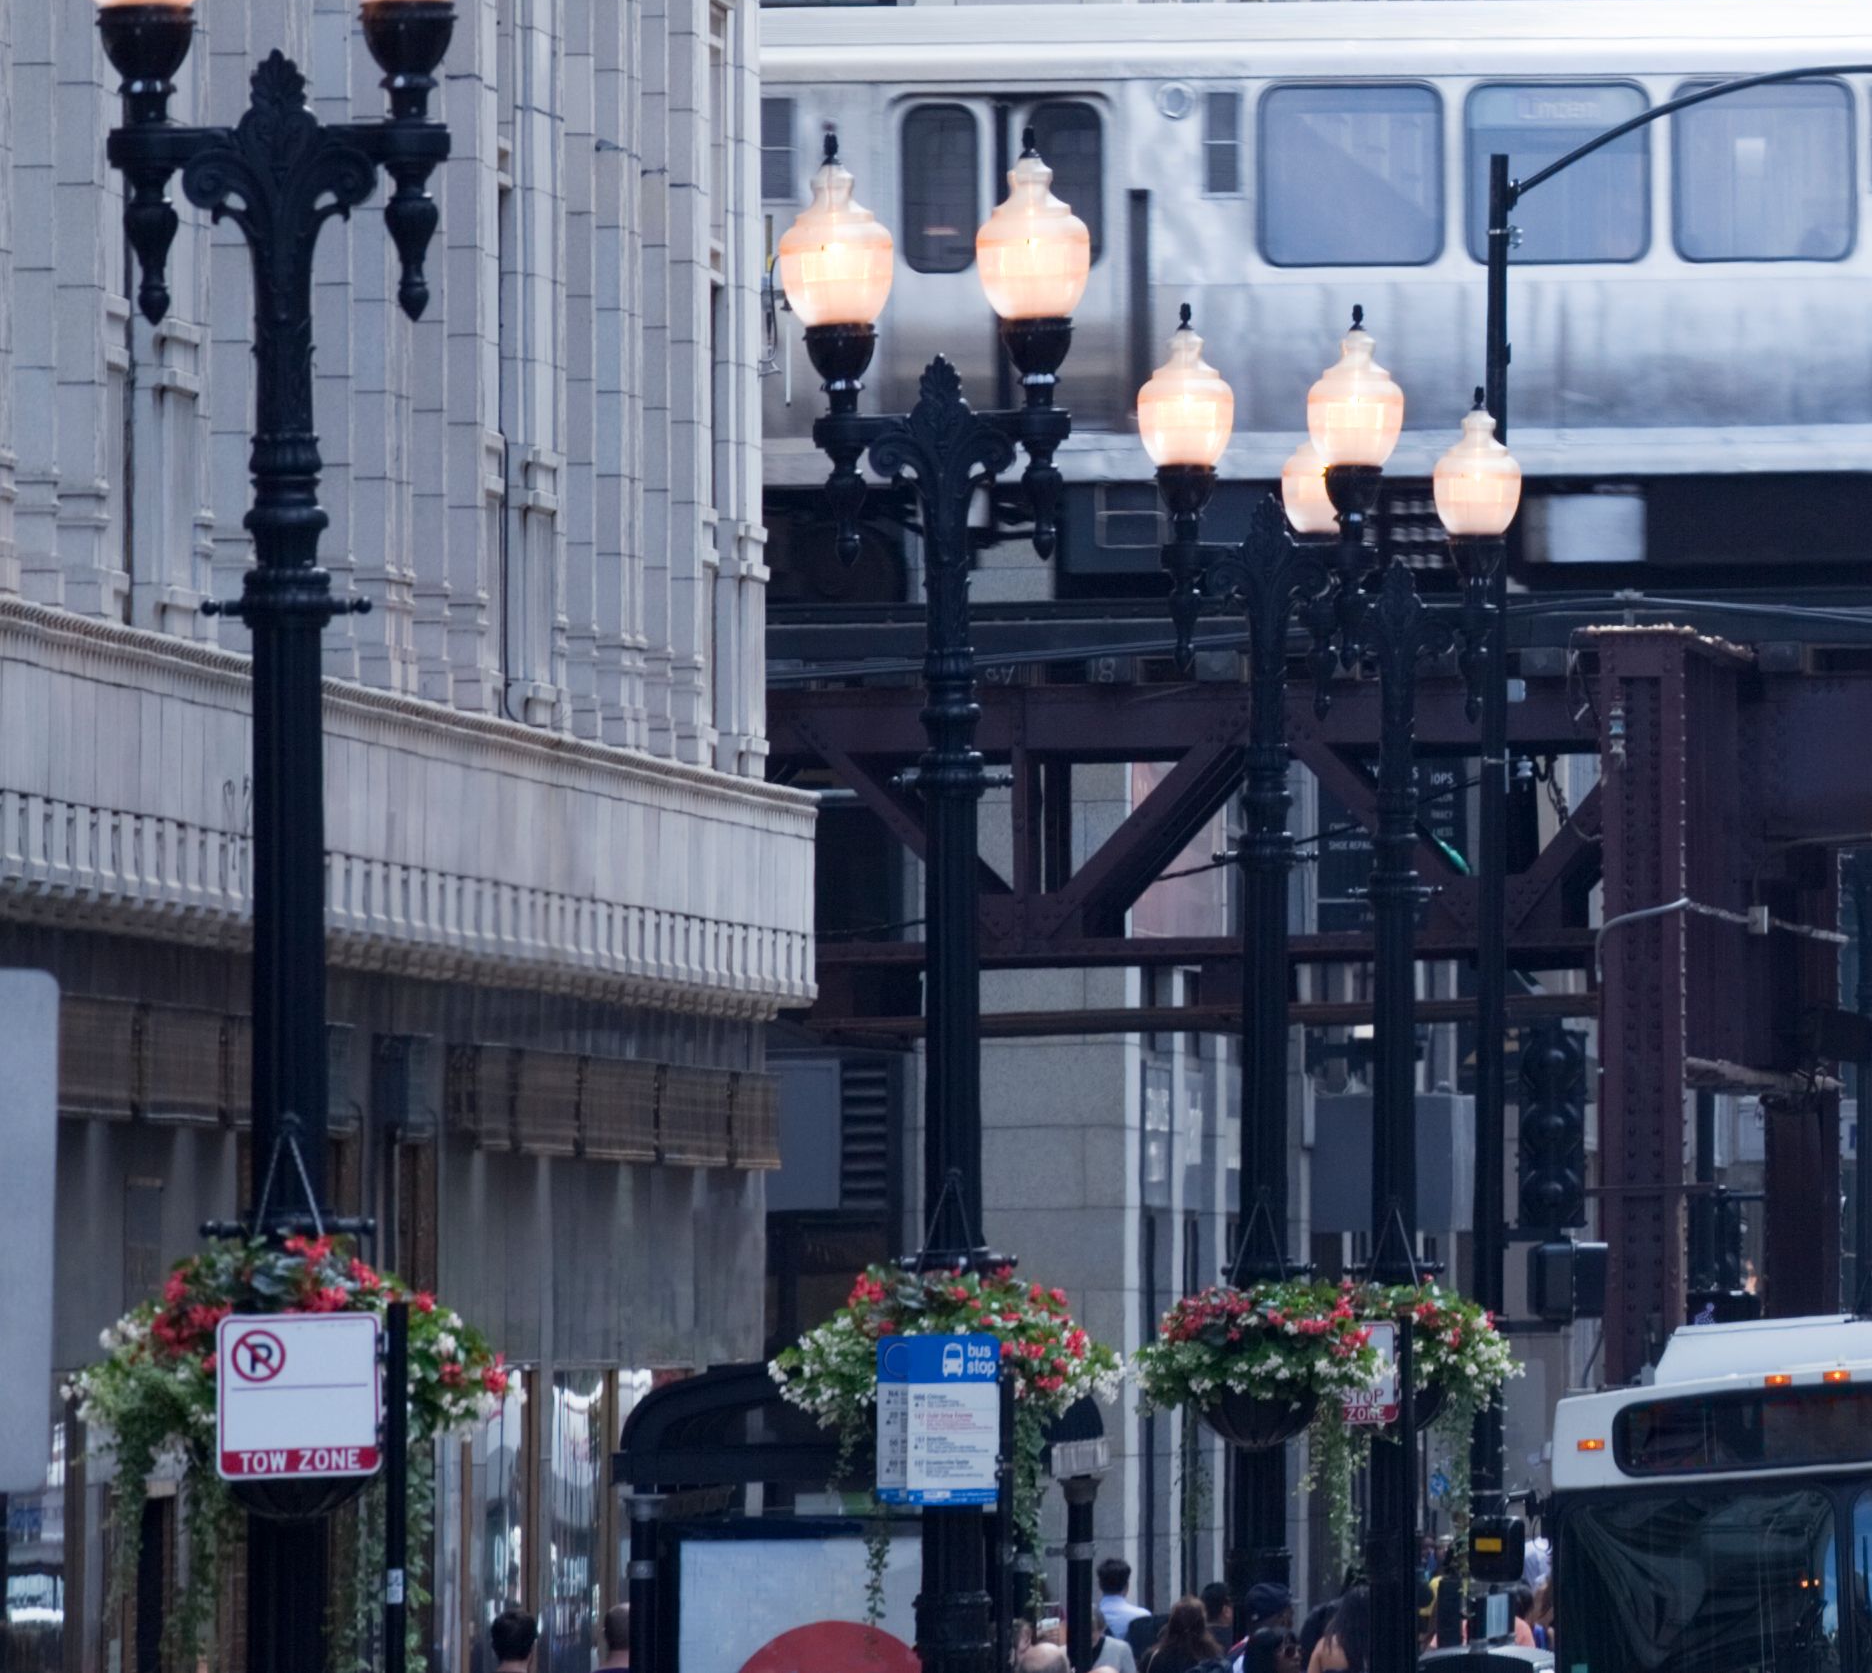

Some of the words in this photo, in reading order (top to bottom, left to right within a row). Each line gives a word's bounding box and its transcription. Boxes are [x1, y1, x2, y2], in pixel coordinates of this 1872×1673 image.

[967, 1342, 991, 1358] bus
[966, 1359, 997, 1378] stop
[1346, 1407, 1386, 1420] ZONE
[239, 1451, 287, 1473] TOW
[298, 1449, 361, 1471] ZONE
